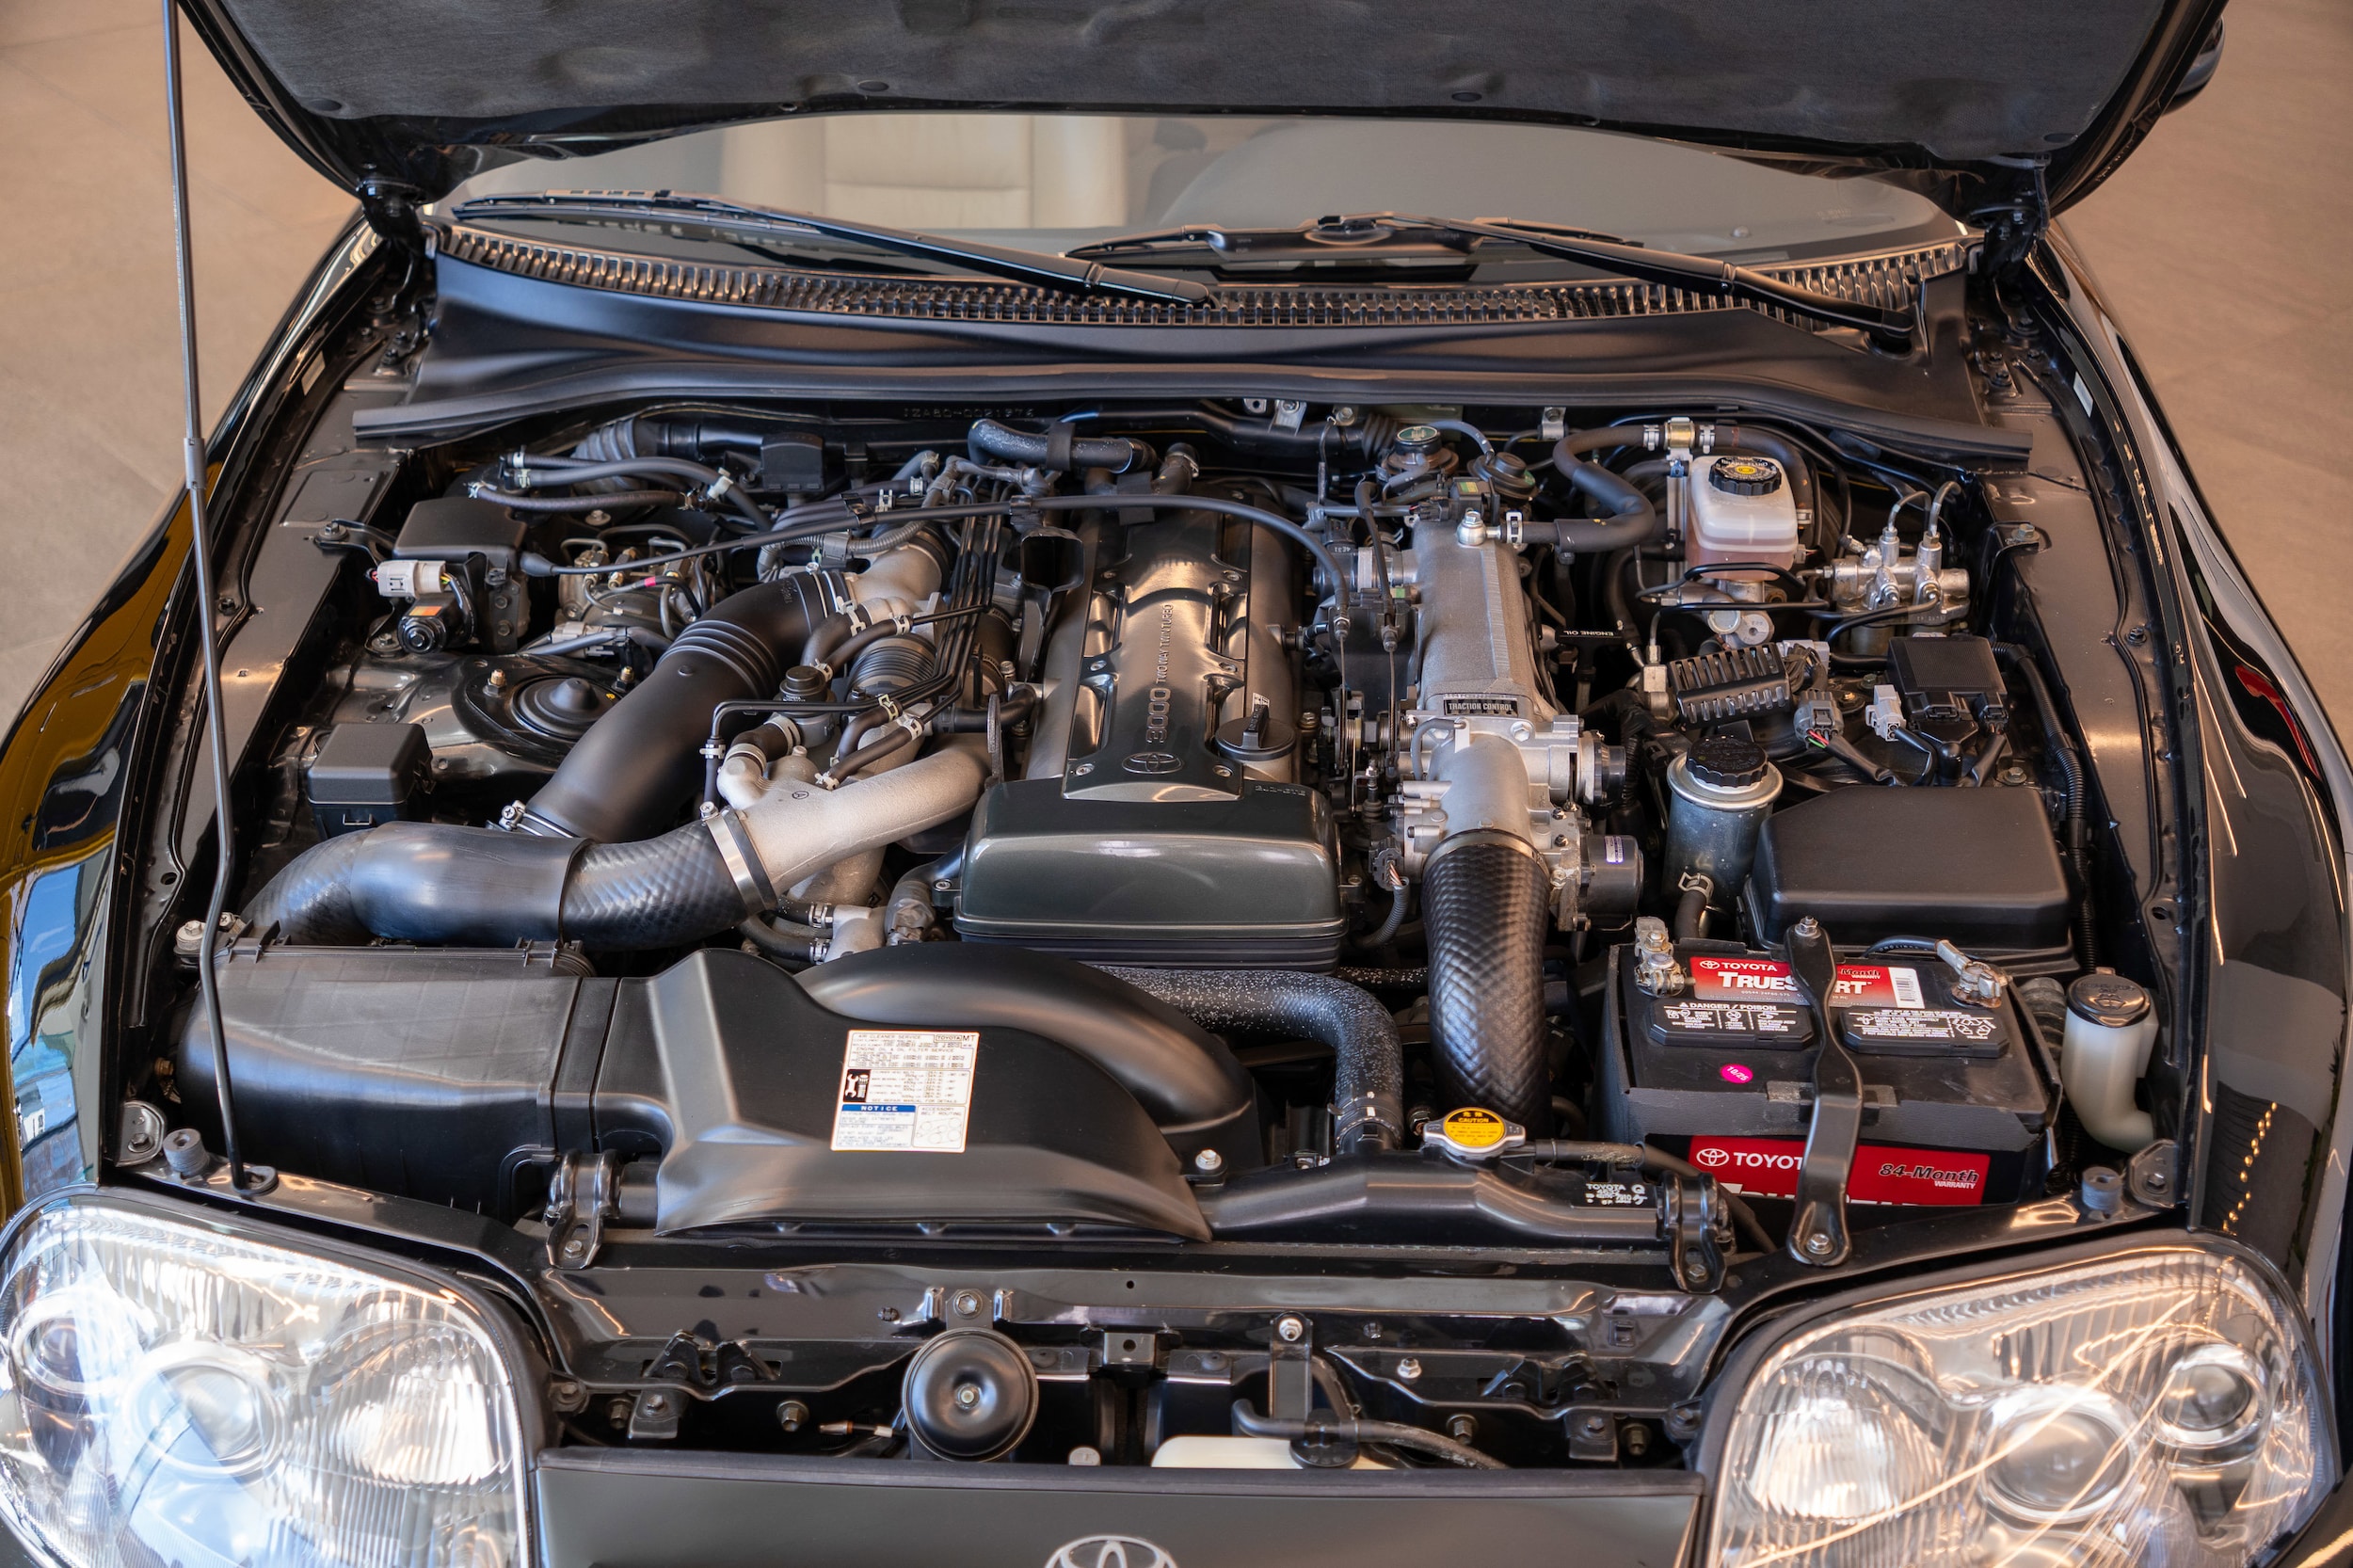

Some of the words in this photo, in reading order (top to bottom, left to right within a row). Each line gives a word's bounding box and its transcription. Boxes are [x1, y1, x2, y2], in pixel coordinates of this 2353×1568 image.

[1160, 603, 1174, 629] TURBO
[1160, 629, 1172, 648] TWIN
[1157, 648, 1170, 664] WAY
[1156, 664, 1168, 684] TWO
[1145, 687, 1172, 744] 3000
[1448, 702, 1481, 711] TRACTION
[1482, 702, 1513, 712] CONTROL
[1721, 962, 1778, 972] TOYOTA
[1879, 1163, 1980, 1183] 84-Month
[1933, 1180, 1977, 1190] WARRANTY
